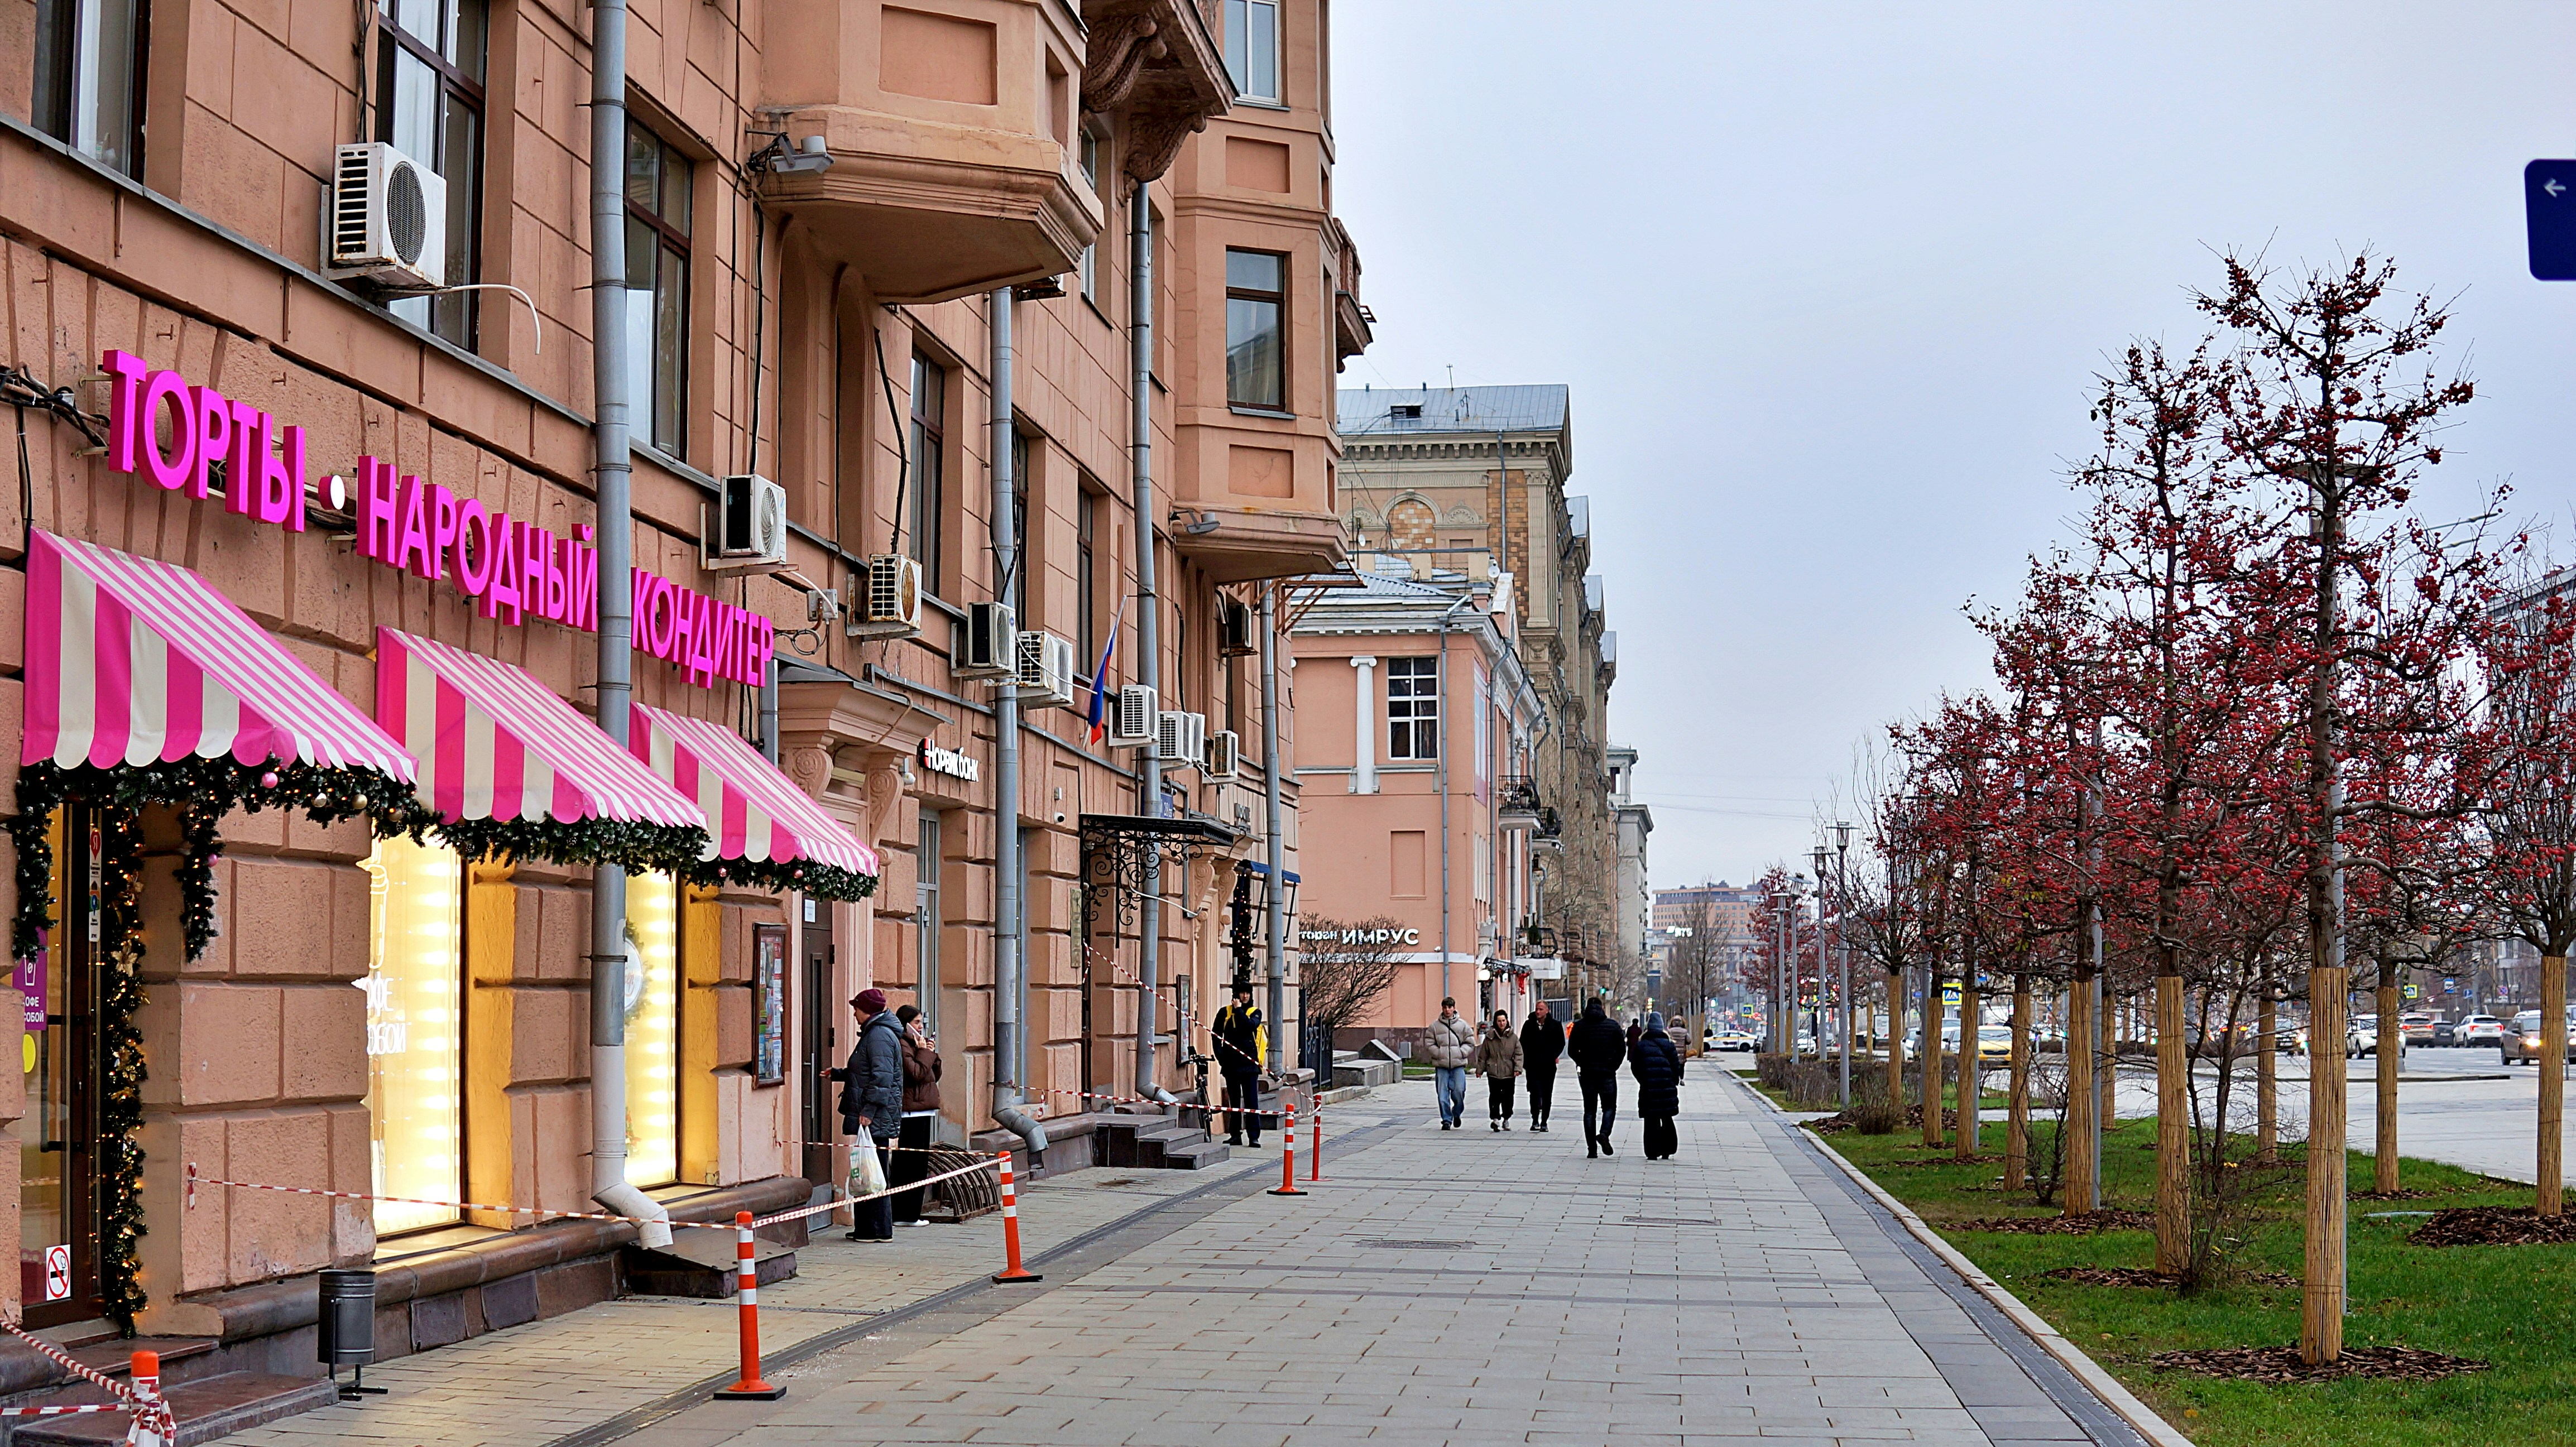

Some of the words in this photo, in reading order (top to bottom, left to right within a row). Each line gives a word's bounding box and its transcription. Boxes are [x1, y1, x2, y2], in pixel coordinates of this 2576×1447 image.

[103, 349, 305, 533] ТОРТЫ
[357, 455, 597, 632] НАРОДНЫЙ
[630, 567, 774, 689] КОНДИТЕР
[1298, 929, 1337, 940] торан
[1342, 929, 1419, 945] ИМРУС
[23, 997, 40, 1007] ОФЕ
[358, 971, 394, 1017] ОФЕ
